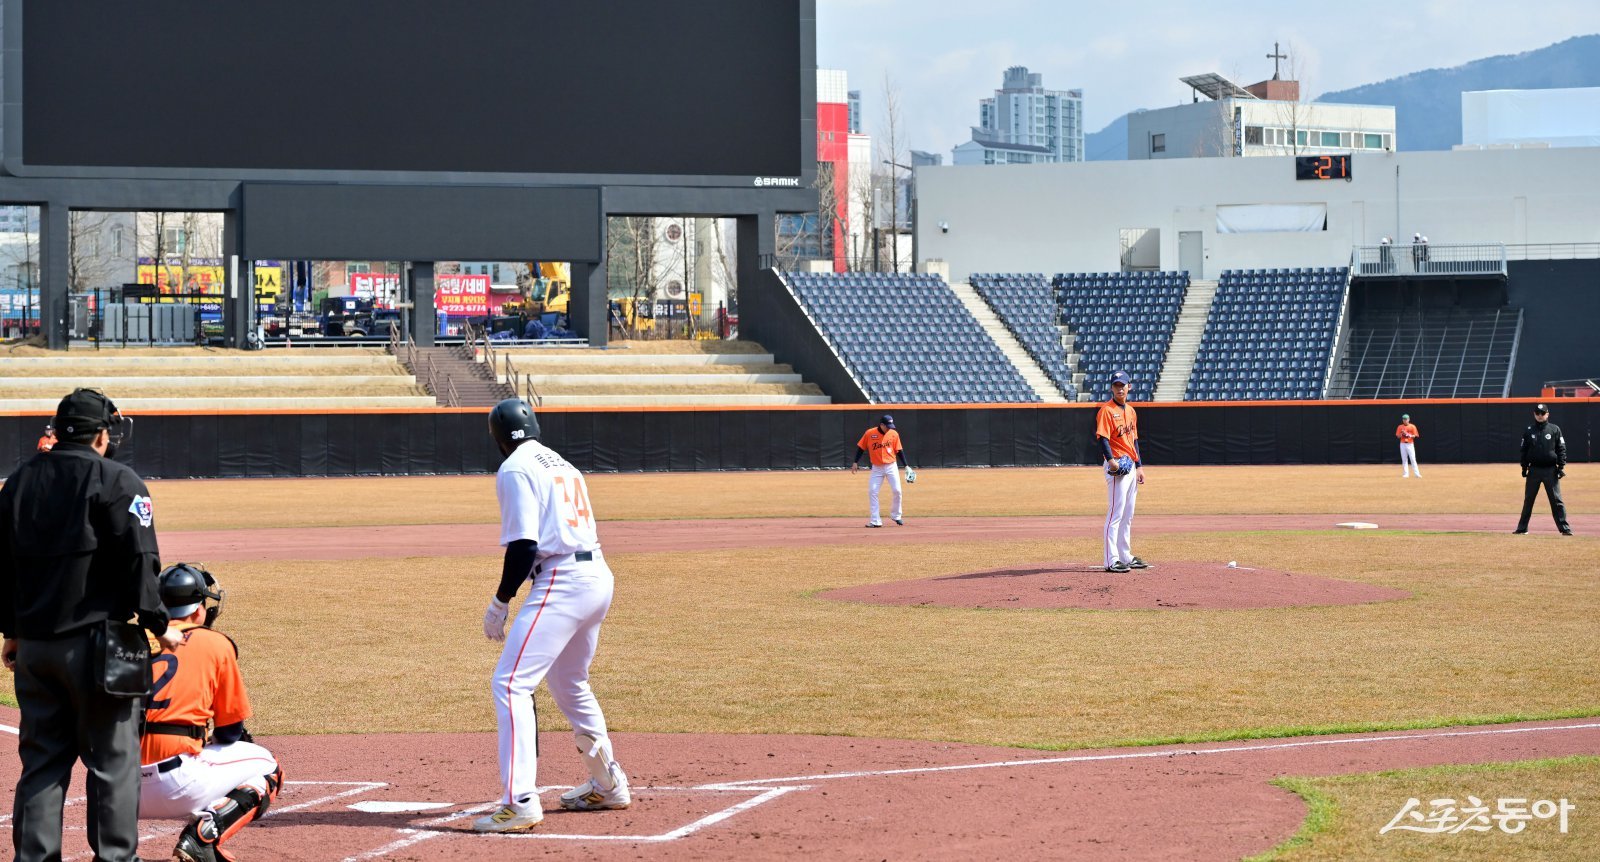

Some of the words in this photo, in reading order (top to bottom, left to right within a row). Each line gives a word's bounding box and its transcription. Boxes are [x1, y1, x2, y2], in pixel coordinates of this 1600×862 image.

[763, 177, 799, 186] SAMIK
[449, 304, 486, 312] 223-6774
[511, 429, 525, 440] 30
[553, 476, 590, 529] 34
